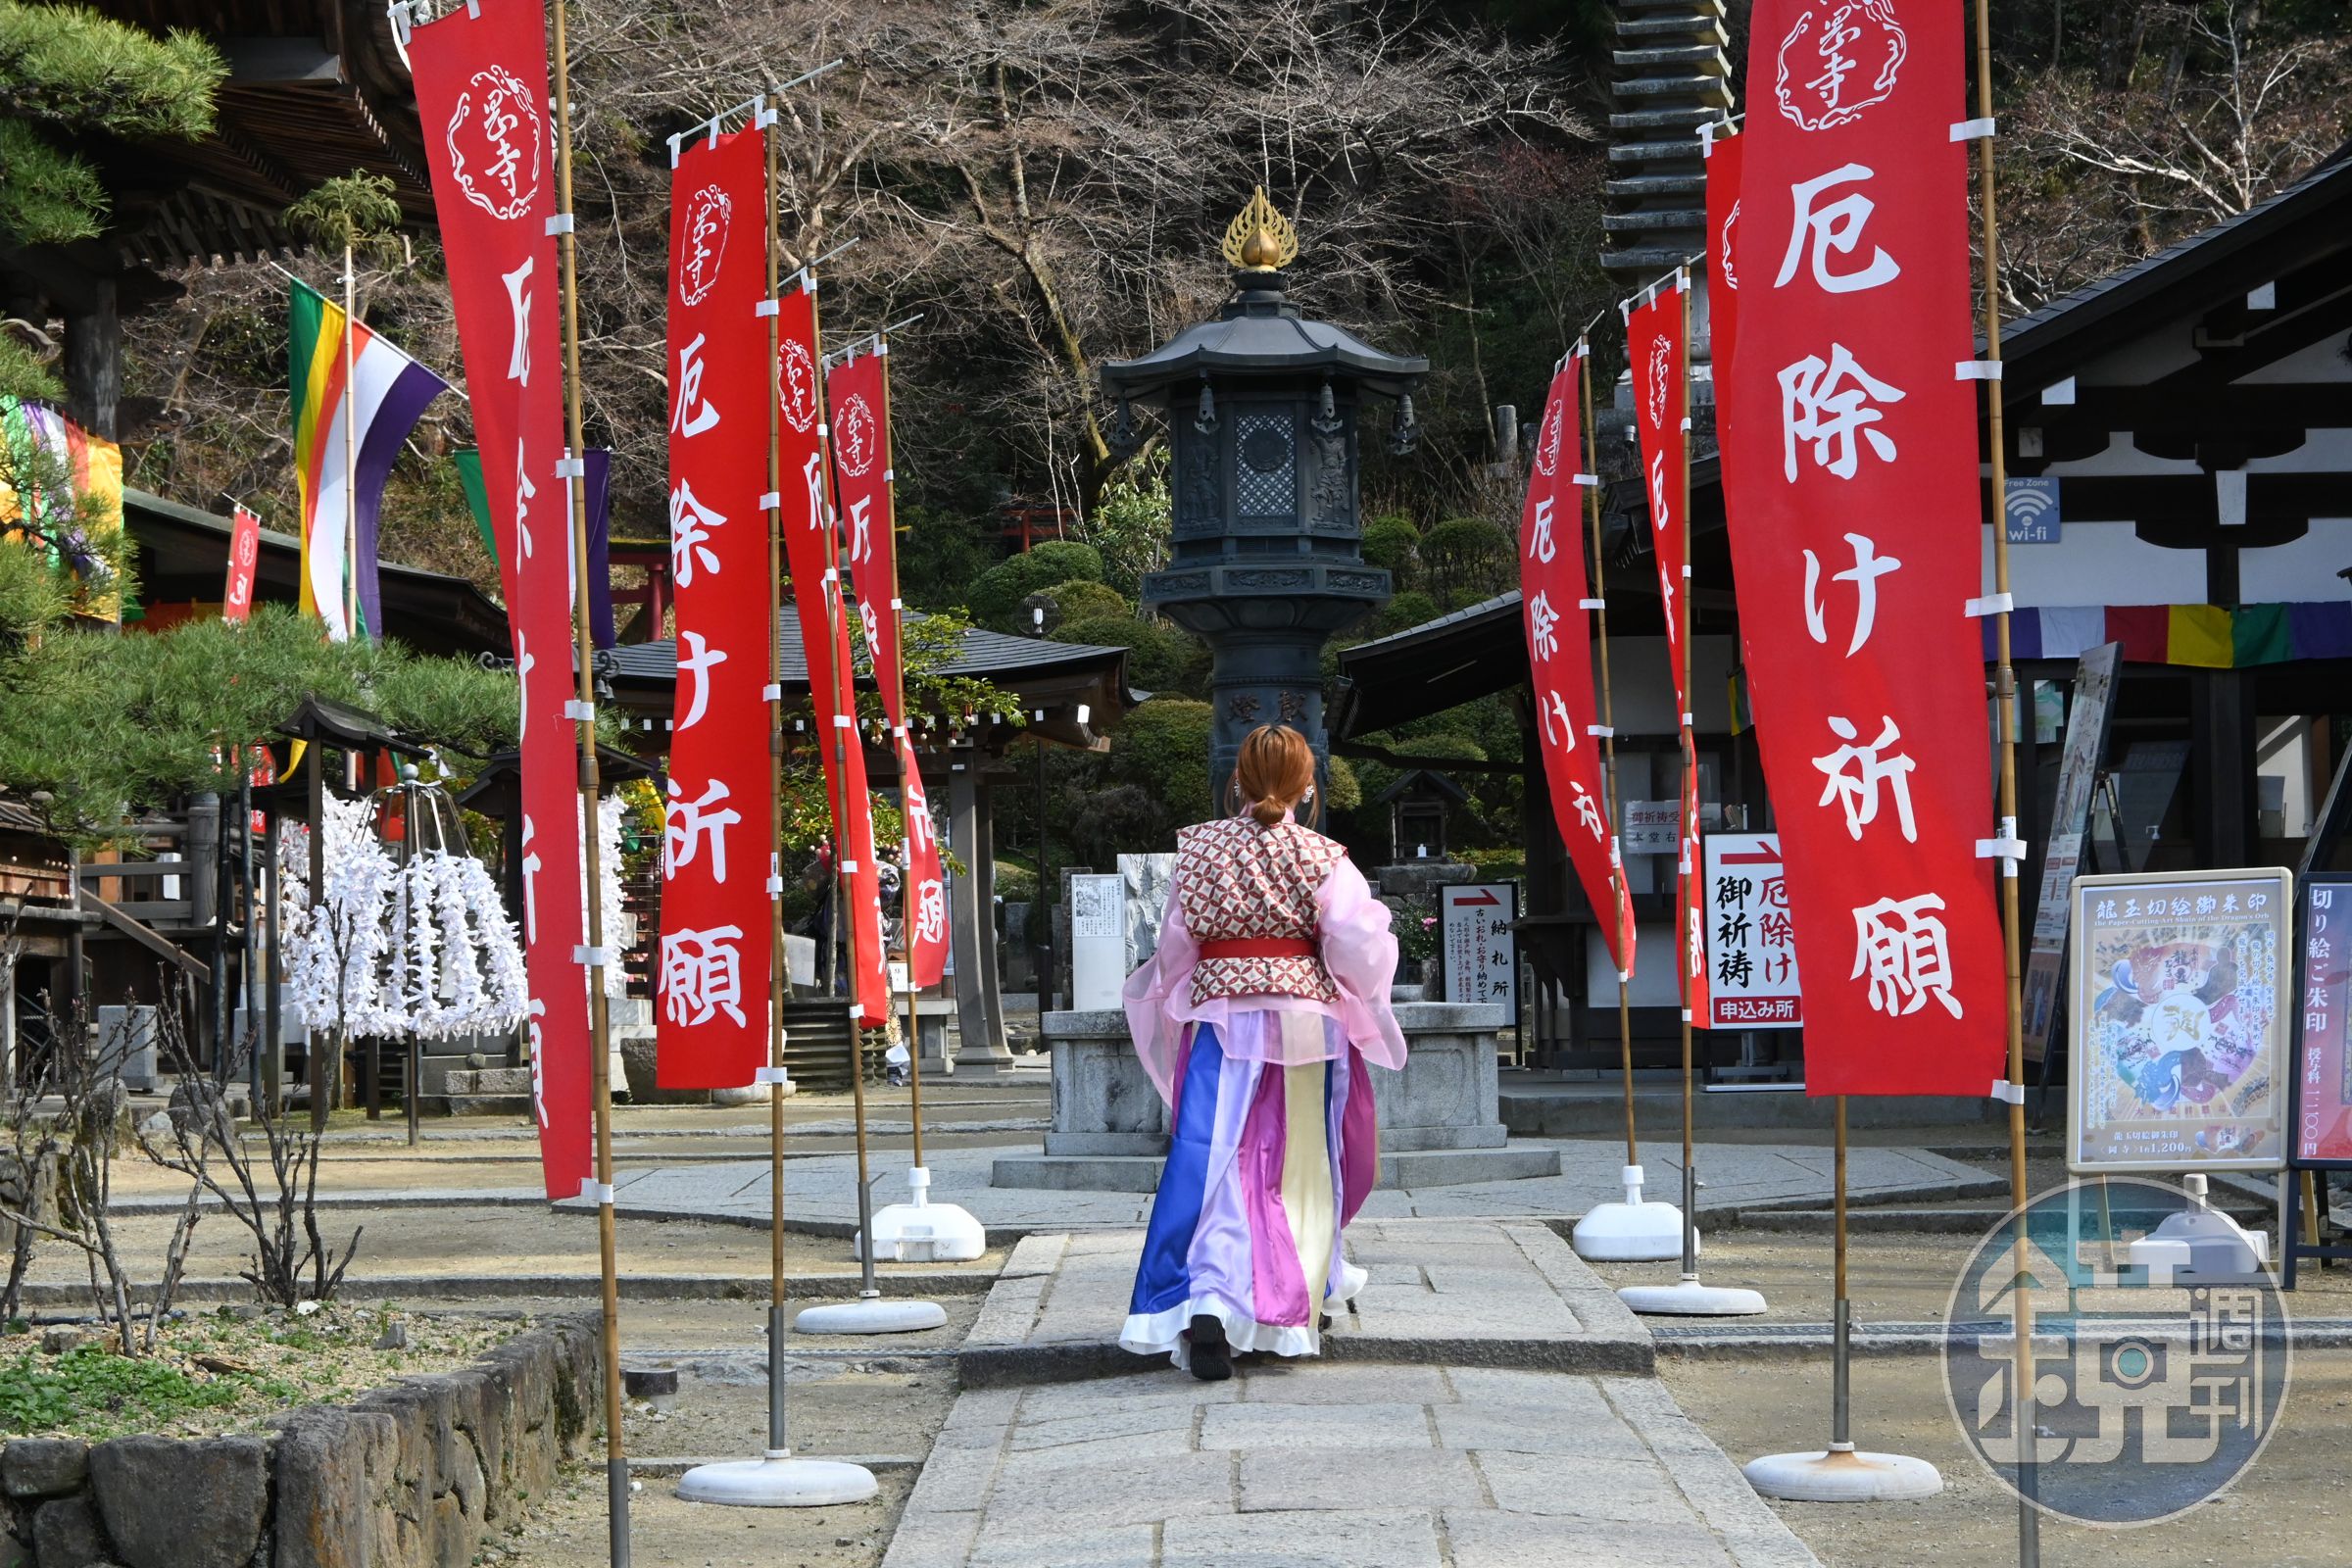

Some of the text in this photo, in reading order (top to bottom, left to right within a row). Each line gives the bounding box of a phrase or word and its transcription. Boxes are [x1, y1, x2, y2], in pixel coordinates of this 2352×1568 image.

[2027, 478, 2049, 487] Zone
[2009, 526, 2047, 541] wi-fi
[1773, 162, 1964, 1019] 厄除け祈願
[1715, 875, 1753, 989] 御祈祷
[1758, 875, 1795, 987] 厄除け
[2095, 893, 2268, 919] 龍玉切絵御朱印
[1490, 919, 1510, 998] 納札所
[2305, 888, 2332, 1034] 切り絵ご朱印
[1720, 1001, 1794, 1020] 申込み所
